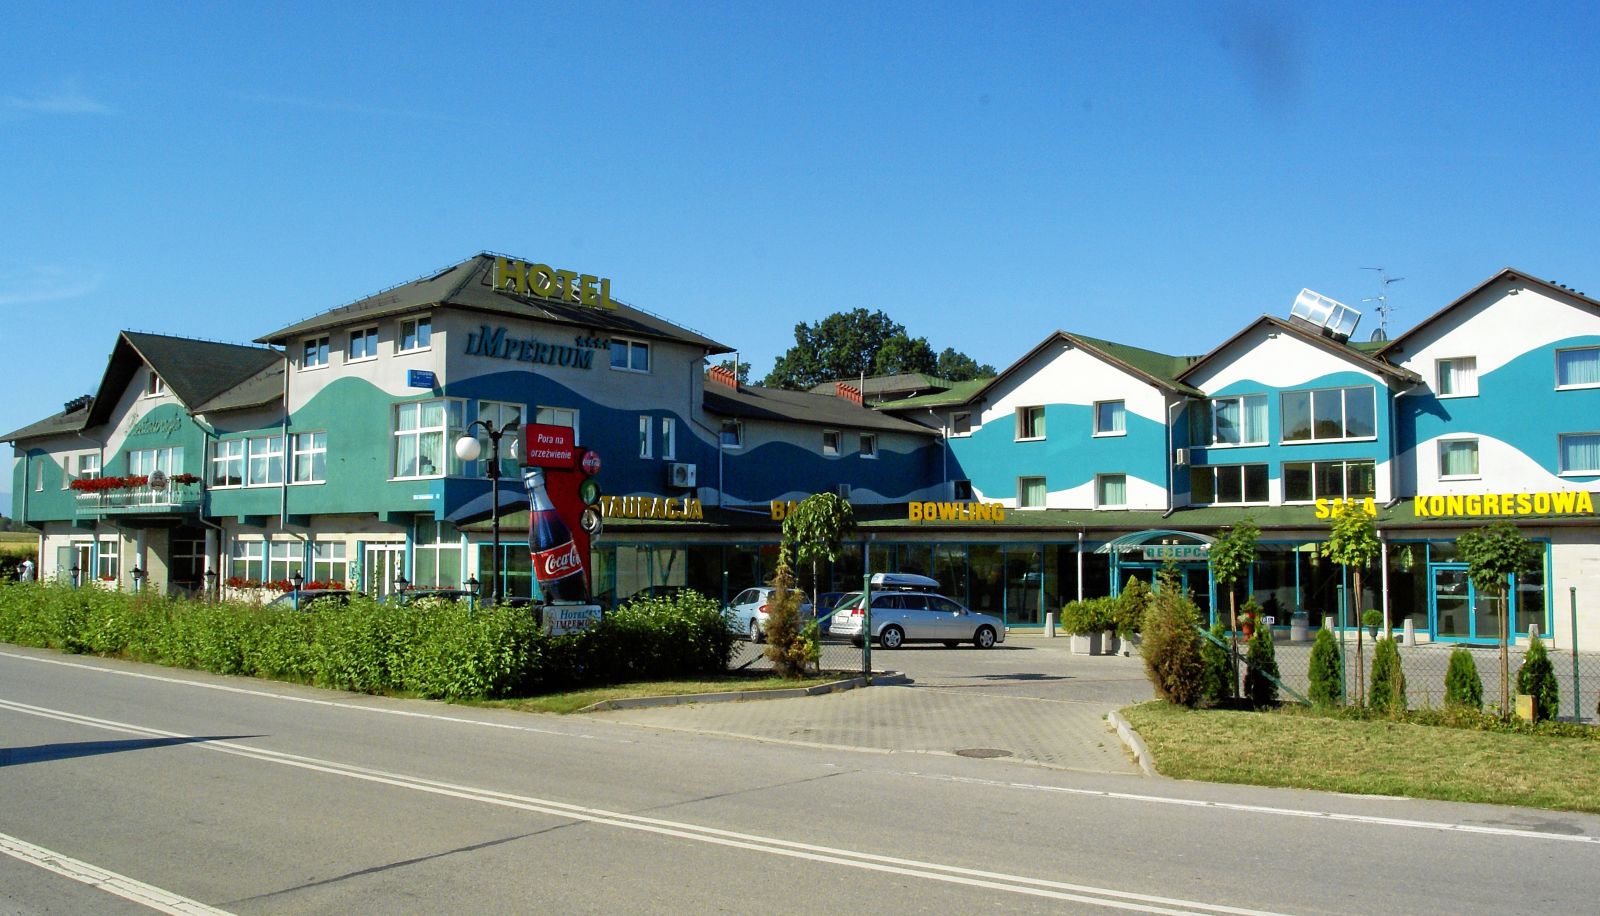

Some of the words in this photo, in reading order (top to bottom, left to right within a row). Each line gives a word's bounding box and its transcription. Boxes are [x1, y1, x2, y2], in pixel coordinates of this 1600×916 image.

[494, 256, 617, 311] HOTEL
[464, 325, 595, 370] IMPERIUM
[537, 433, 554, 444] Pora
[555, 436, 564, 444] na
[590, 496, 703, 519] TAURACJA
[771, 500, 798, 520] BA
[908, 501, 1005, 521] BOWLING
[1414, 491, 1594, 517] KONGRESOWA
